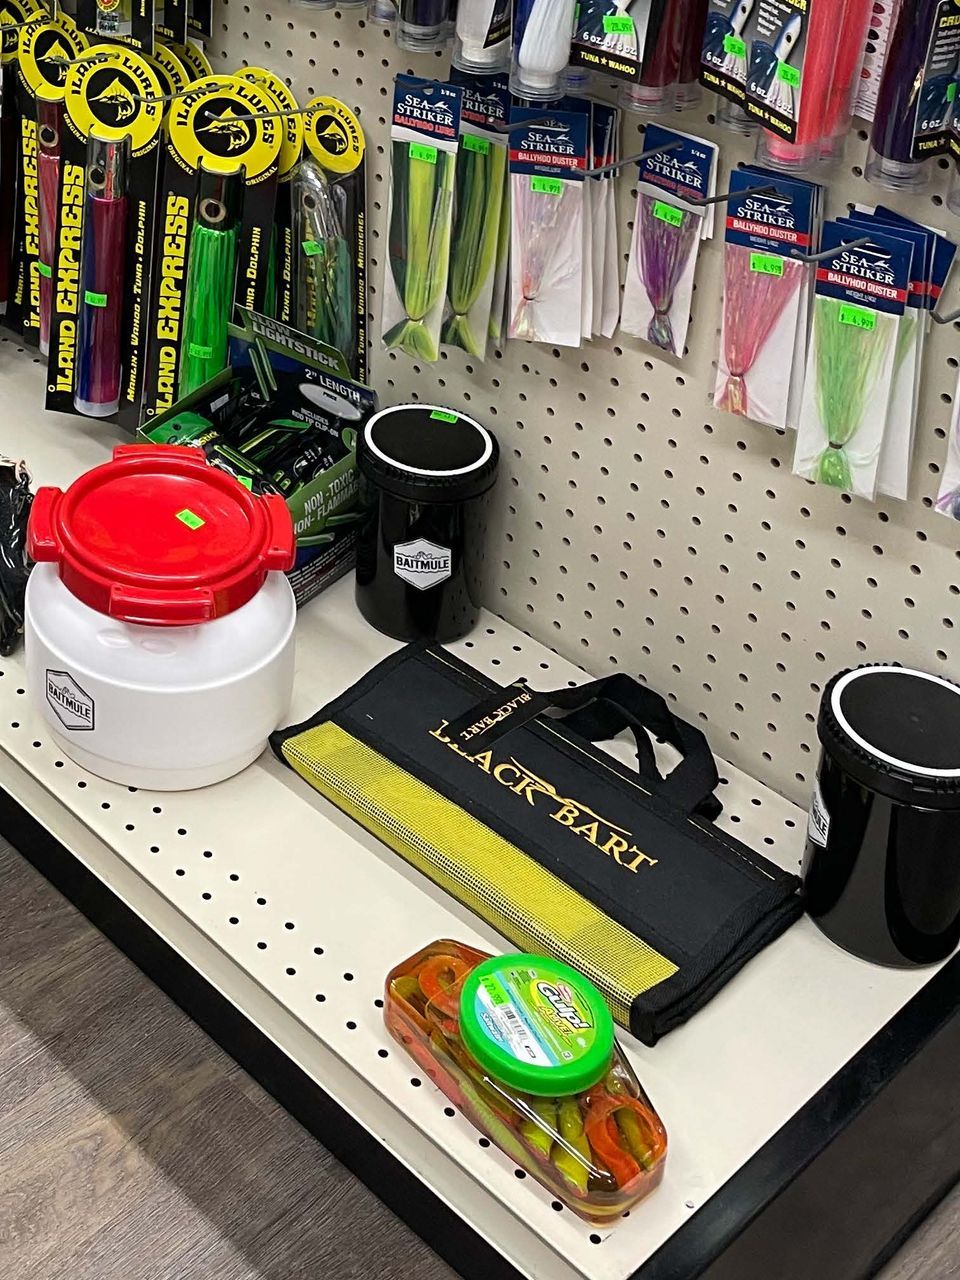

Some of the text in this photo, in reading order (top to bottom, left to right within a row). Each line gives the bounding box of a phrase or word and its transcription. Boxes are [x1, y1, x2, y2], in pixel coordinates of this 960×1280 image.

[580, 52, 636, 75] TUNA WAHOO
[70, 53, 156, 117] ILAND LURES
[176, 81, 273, 145] ILAND LURES
[397, 103, 453, 126] STRIKER
[405, 94, 429, 111] SEA
[521, 140, 575, 155] STRIKER
[528, 132, 552, 144] SEA
[167, 145, 193, 176] ORIGINAL
[518, 152, 578, 167] BALLYHOO DUSTER
[655, 152, 678, 166] SEA
[646, 158, 702, 189] STRIKER
[737, 207, 795, 229] STRIKER
[745, 199, 770, 212] SEA
[733, 220, 798, 242] BALLYHOO DUSTER
[157, 195, 189, 342] EXPRESS
[832, 259, 894, 285] STRIKER
[841, 252, 868, 267] SEA
[49, 164, 86, 394] ILAND EXPRESS
[828, 272, 898, 299] BALLYHOO DUSTER
[127, 201, 146, 402] MARLIN WAHOO TUNA DOLPHIN
[253, 321, 340, 370] LIGHTSTICK
[320, 376, 361, 402] LENGTH
[300, 408, 329, 426] INCLUDES
[304, 491, 324, 514] NON
[396, 554, 449, 570] BAITMULE
[48, 681, 91, 719] BAITMULE
[459, 692, 532, 741] BLACK BART
[429, 719, 658, 873] BACK BART
[537, 981, 592, 1030] Gulp!
